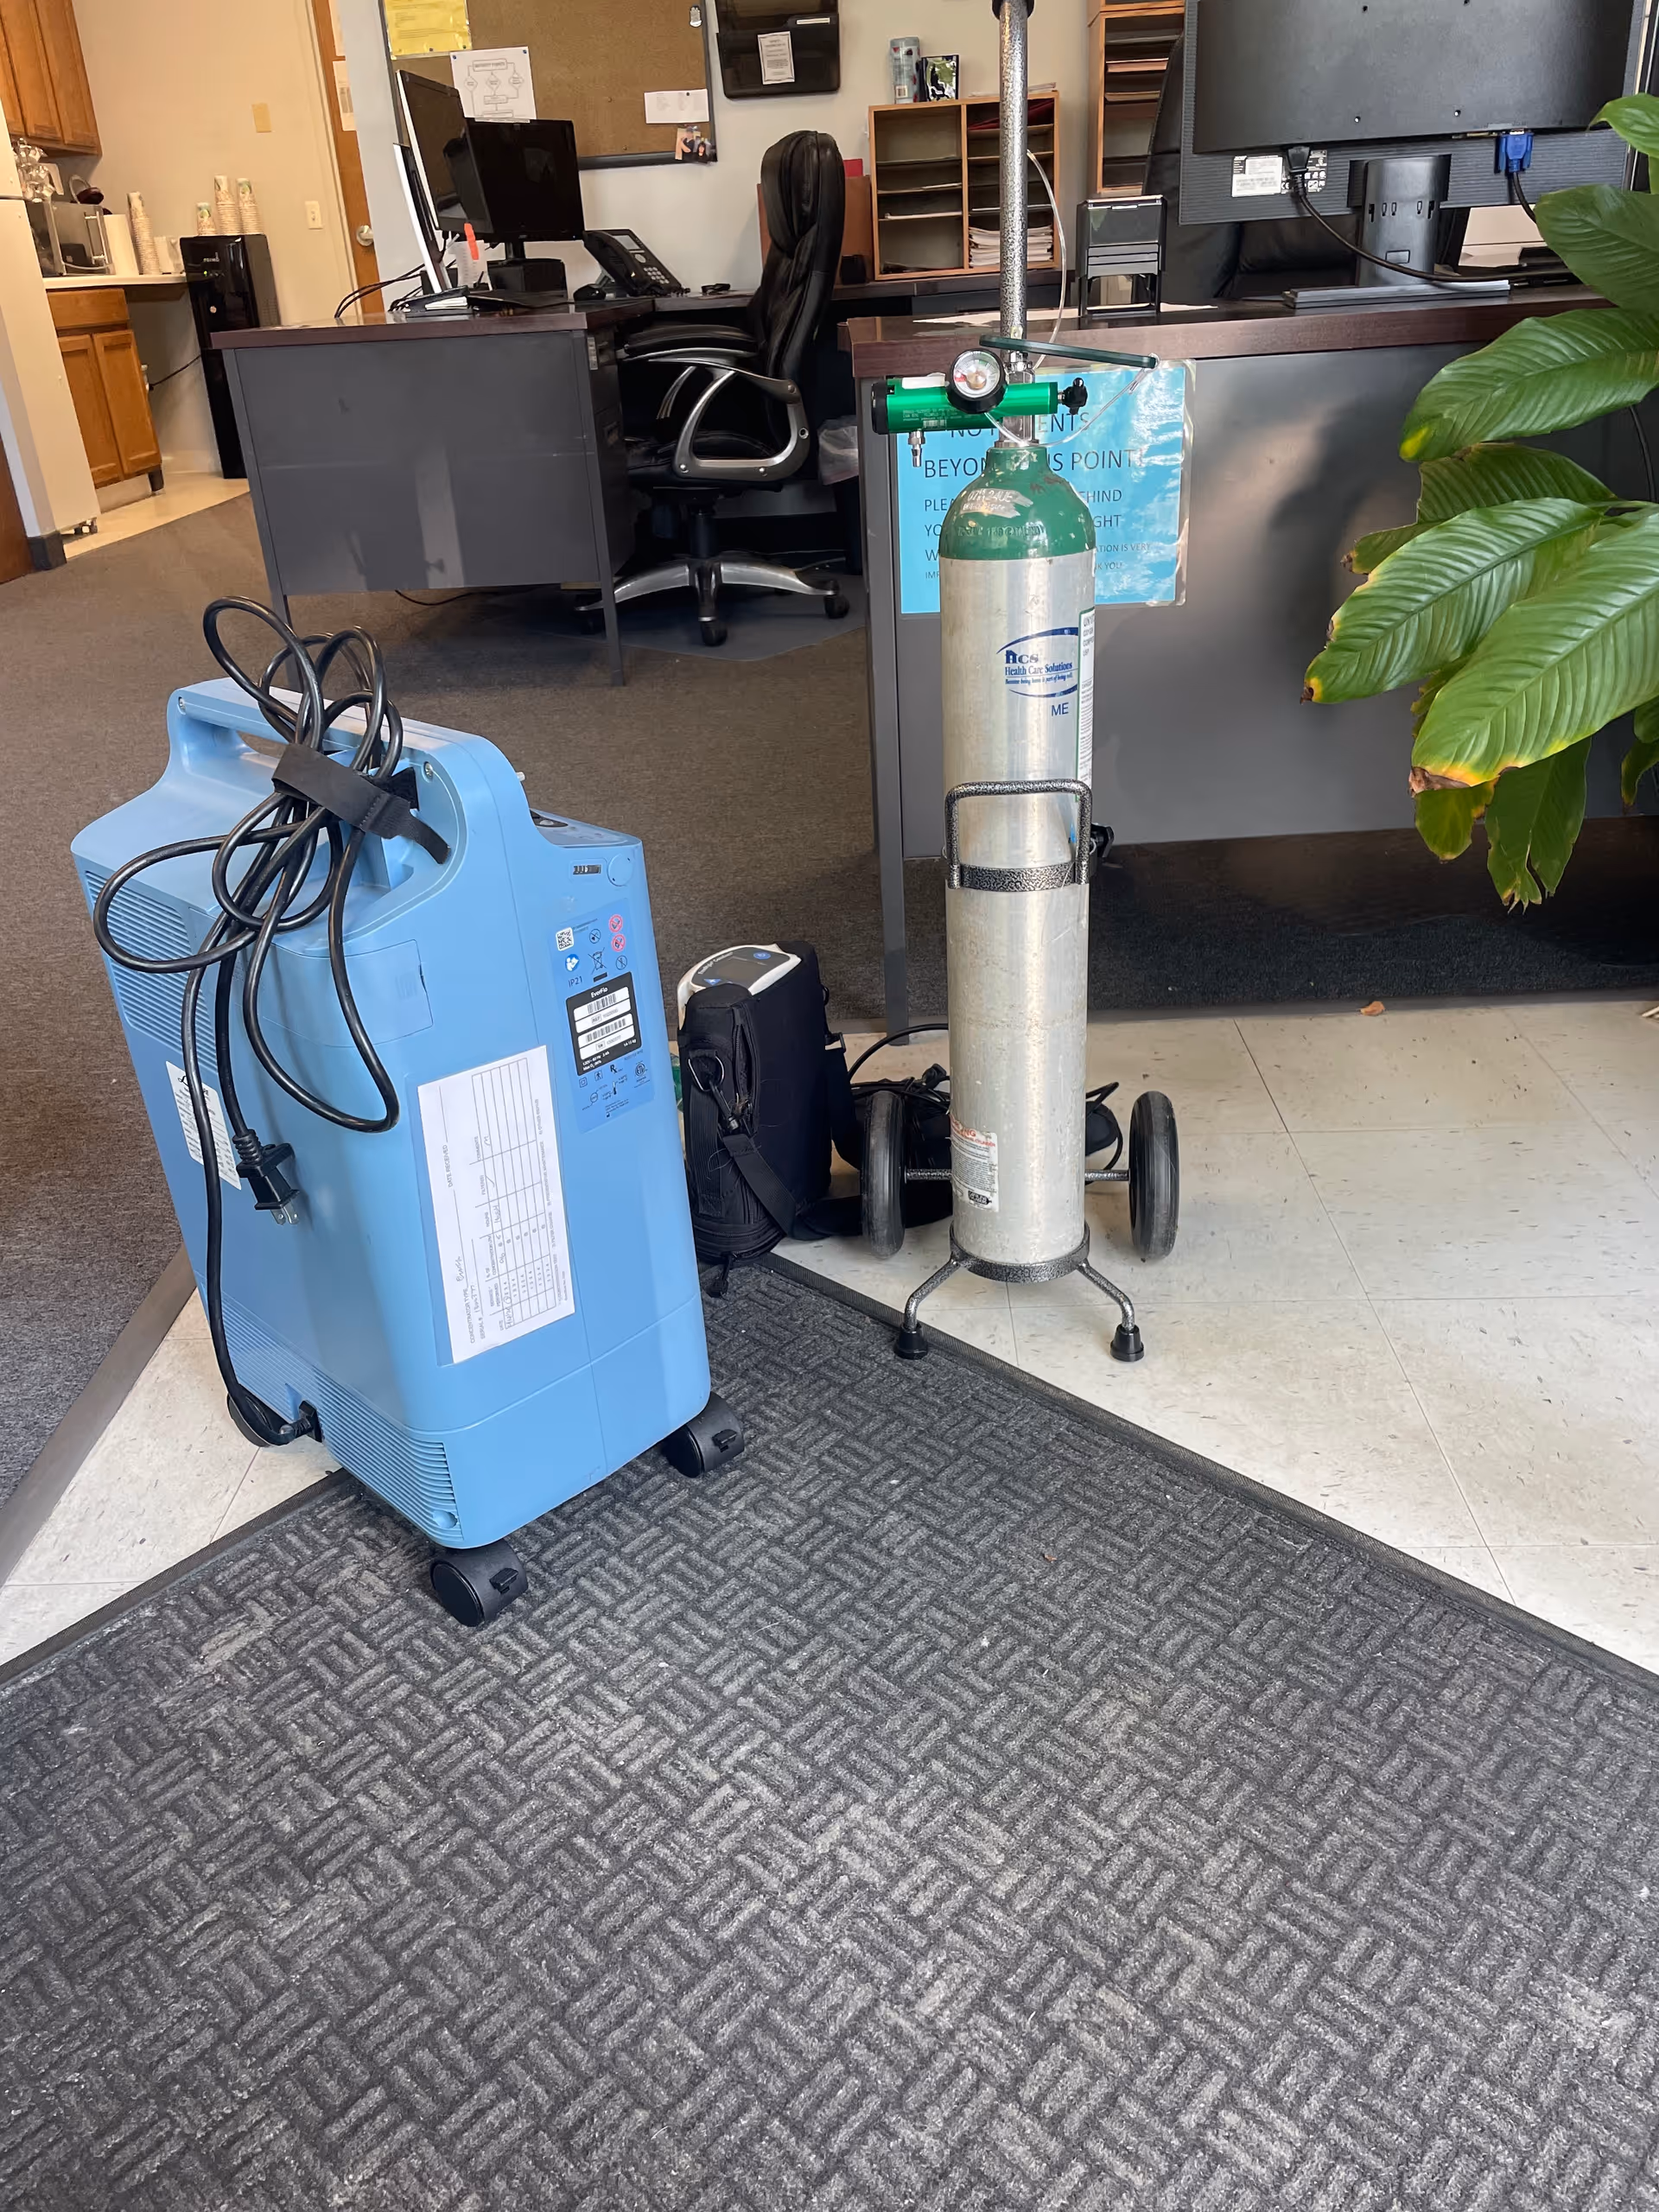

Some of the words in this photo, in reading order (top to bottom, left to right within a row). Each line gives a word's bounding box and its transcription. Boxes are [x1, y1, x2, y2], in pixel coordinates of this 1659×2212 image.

[1005, 666, 1027, 676] Health
[1028, 666, 1043, 675] Care
[1045, 662, 1072, 673] Solutions
[1051, 702, 1069, 716] ME
[569, 976, 582, 988] IP21
[590, 986, 608, 999] EverFlo
[442, 1144, 452, 1171] RECEIVED
[466, 1302, 476, 1344] CONCENTRATOR
